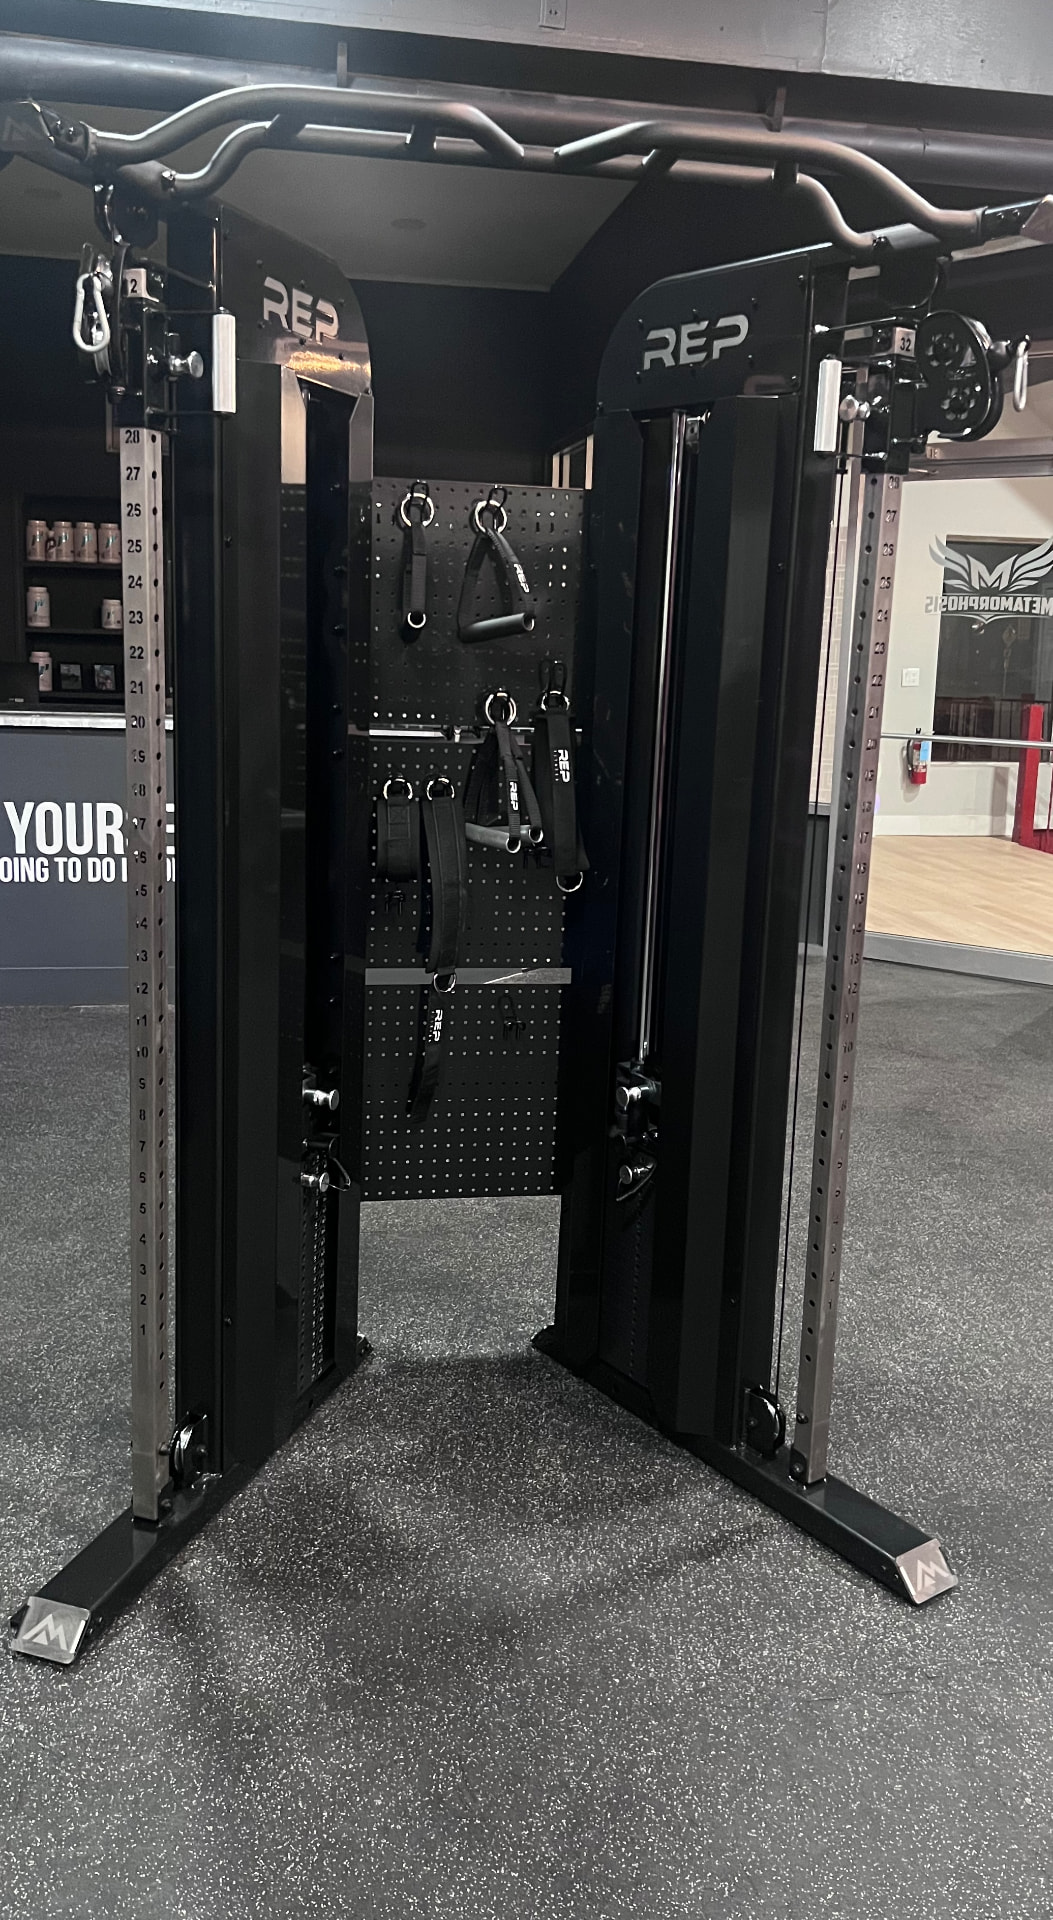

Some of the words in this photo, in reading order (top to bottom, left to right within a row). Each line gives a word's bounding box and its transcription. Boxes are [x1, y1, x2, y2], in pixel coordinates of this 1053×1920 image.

[263, 277, 340, 345] REP
[643, 314, 749, 371] REP
[899, 337, 912, 352] 32
[125, 430, 140, 444] 28
[126, 466, 141, 481] 27
[127, 539, 142, 553] 25
[128, 575, 143, 589] 24
[513, 563, 530, 593] REP
[129, 610, 144, 624] 23
[129, 646, 144, 659] 22
[130, 680, 144, 694] 21
[131, 715, 146, 729] 20
[558, 749, 571, 783] REP
[509, 781, 519, 811] REP
[54, 857, 82, 883] TO
[87, 857, 116, 883] DO
[432, 1009, 443, 1042] REP
